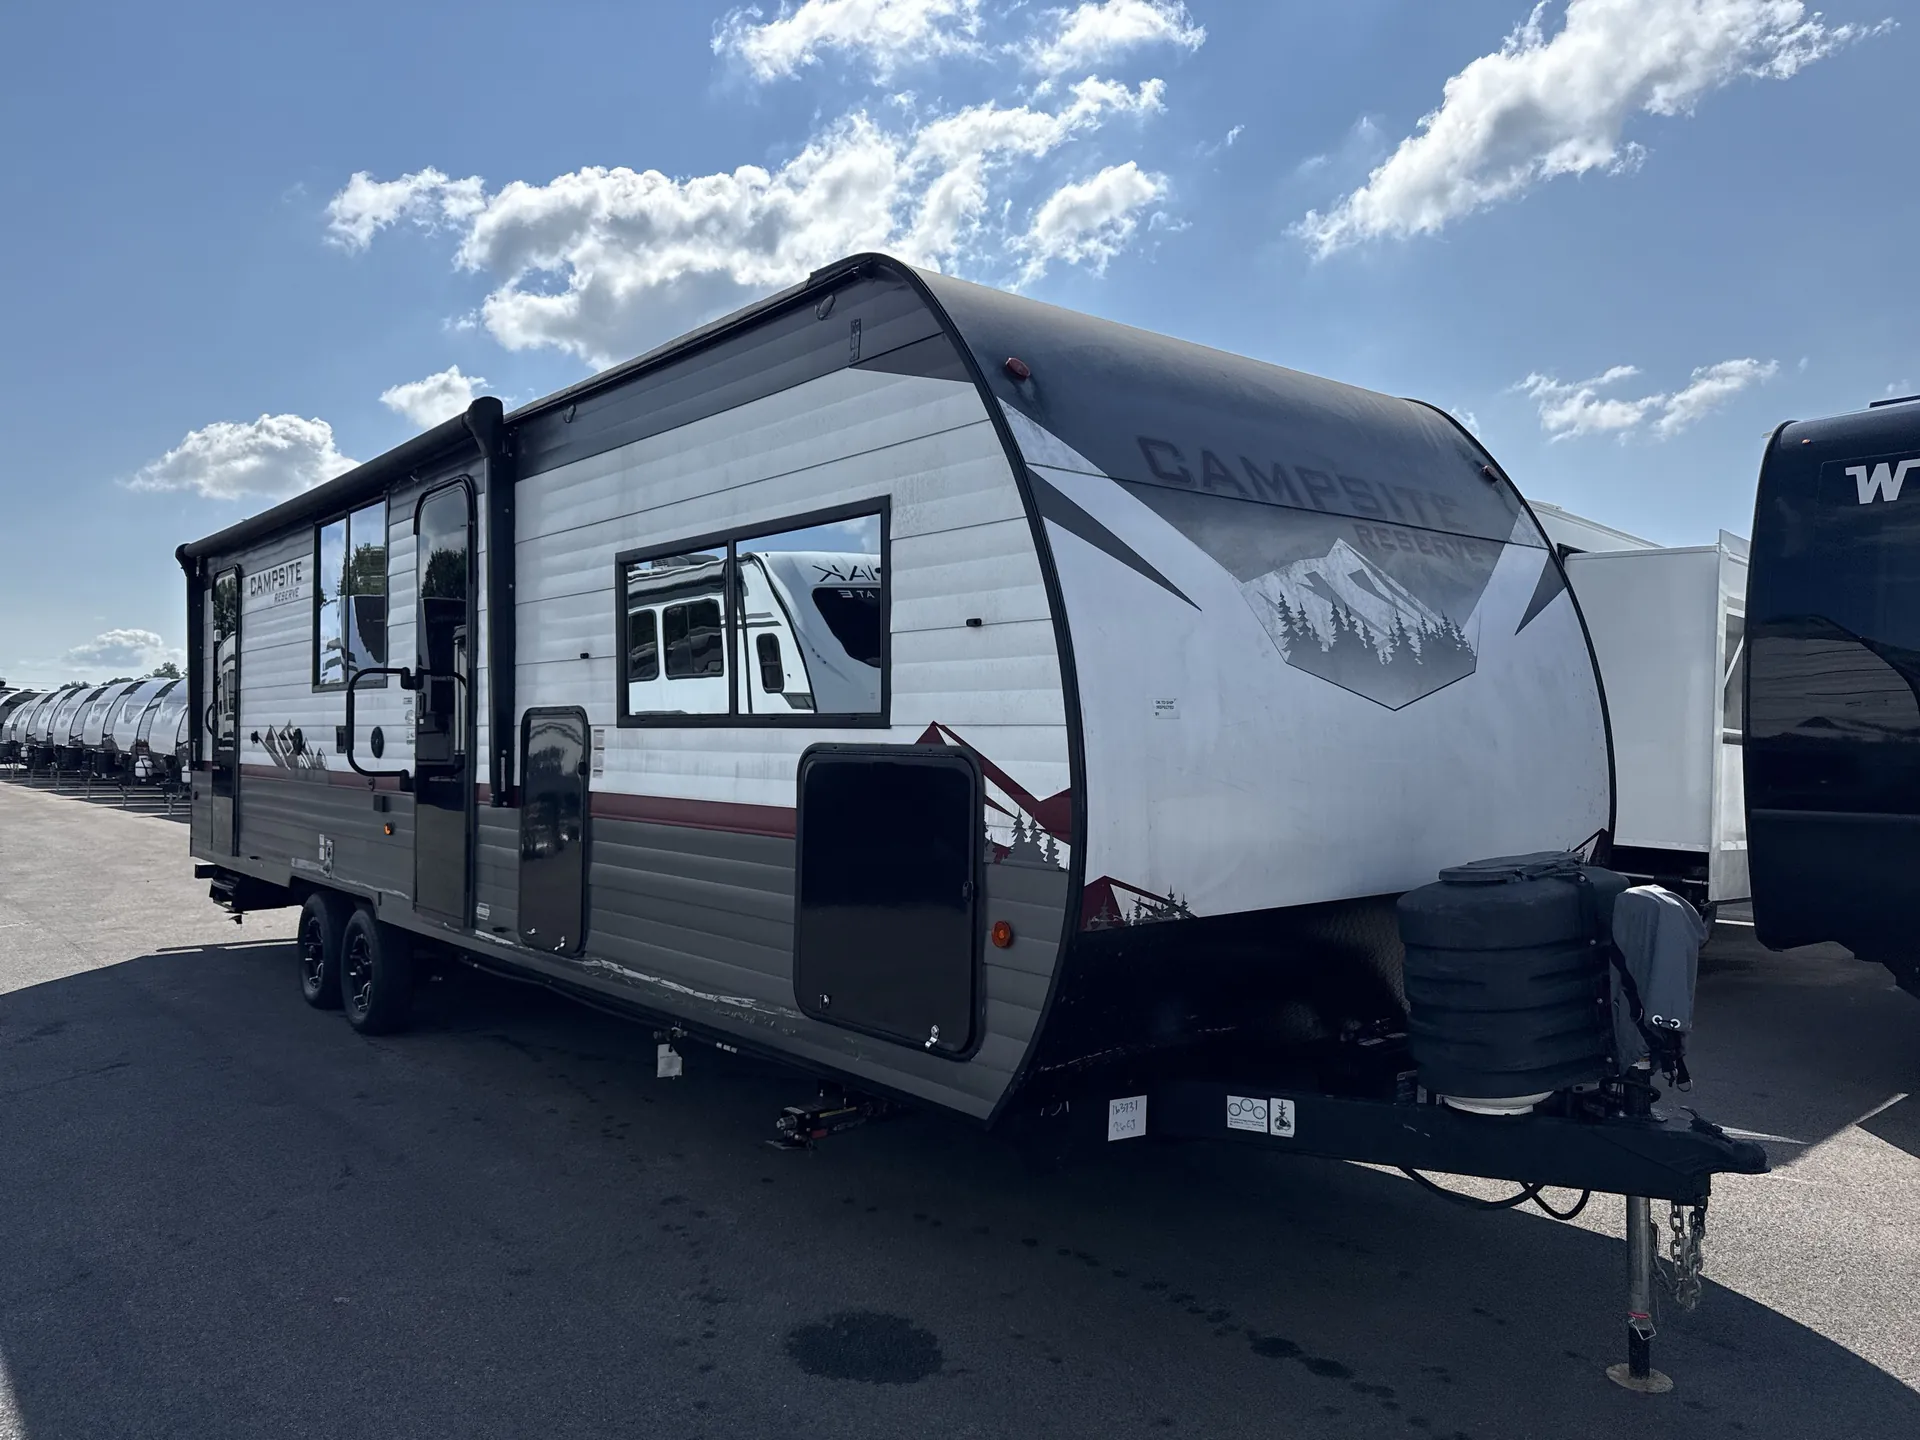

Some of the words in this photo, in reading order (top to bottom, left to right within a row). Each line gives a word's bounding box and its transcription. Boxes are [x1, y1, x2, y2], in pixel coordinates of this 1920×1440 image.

[1136, 436, 1466, 529] CAMPSITE
[1353, 524, 1484, 563] RESERVE
[251, 561, 302, 597] CAMPSITE
[274, 587, 300, 603] RESERVE
